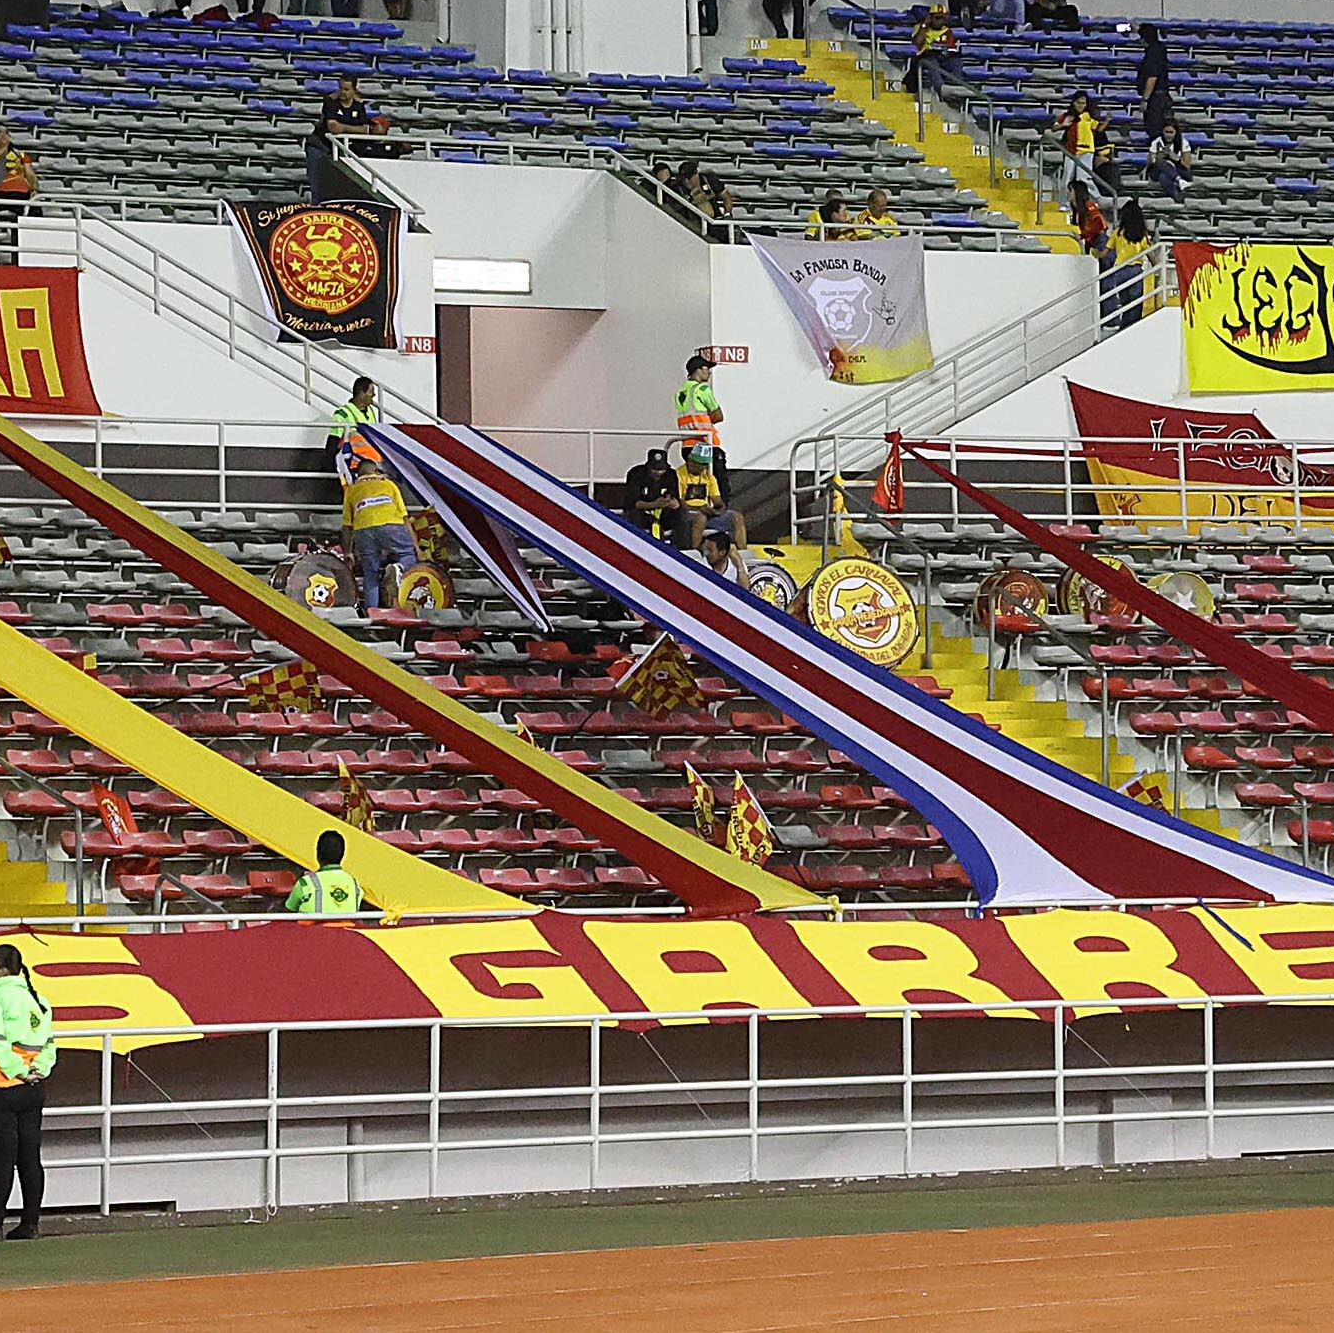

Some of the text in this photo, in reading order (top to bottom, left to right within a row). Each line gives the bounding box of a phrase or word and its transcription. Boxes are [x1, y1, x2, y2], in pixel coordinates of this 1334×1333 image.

[304, 226, 344, 241] LA
[852, 258, 888, 287] BANDA
[306, 280, 346, 298] MAFIA
[411, 337, 432, 353] N8
[725, 347, 745, 362] N8
